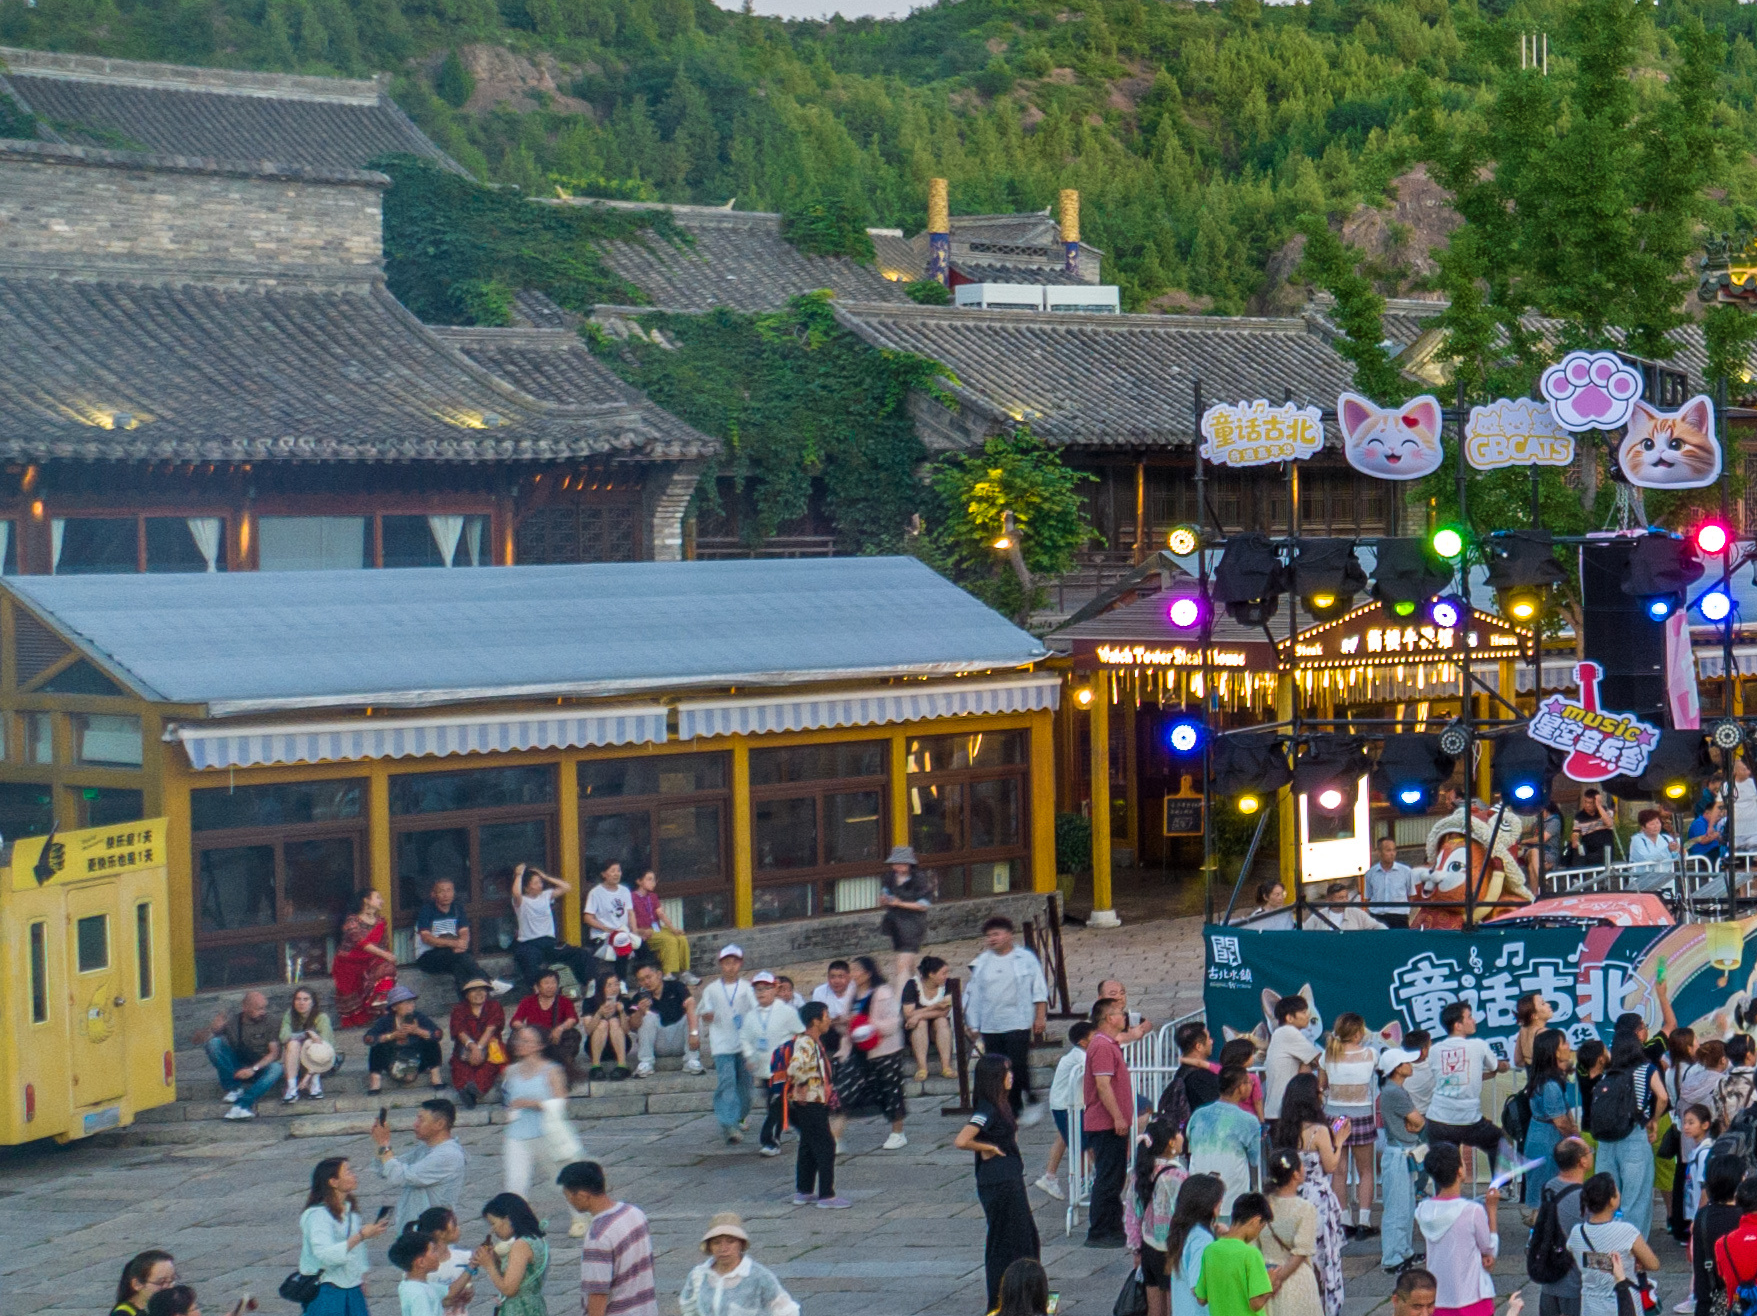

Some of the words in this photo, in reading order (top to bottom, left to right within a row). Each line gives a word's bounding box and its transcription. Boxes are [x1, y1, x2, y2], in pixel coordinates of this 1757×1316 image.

[1208, 412, 1317, 450] 童话古北
[1468, 436, 1574, 467] GBCATS
[1132, 646, 1174, 665] Tower
[1561, 704, 1643, 744] music
[1398, 964, 1646, 1039] 童话古北
